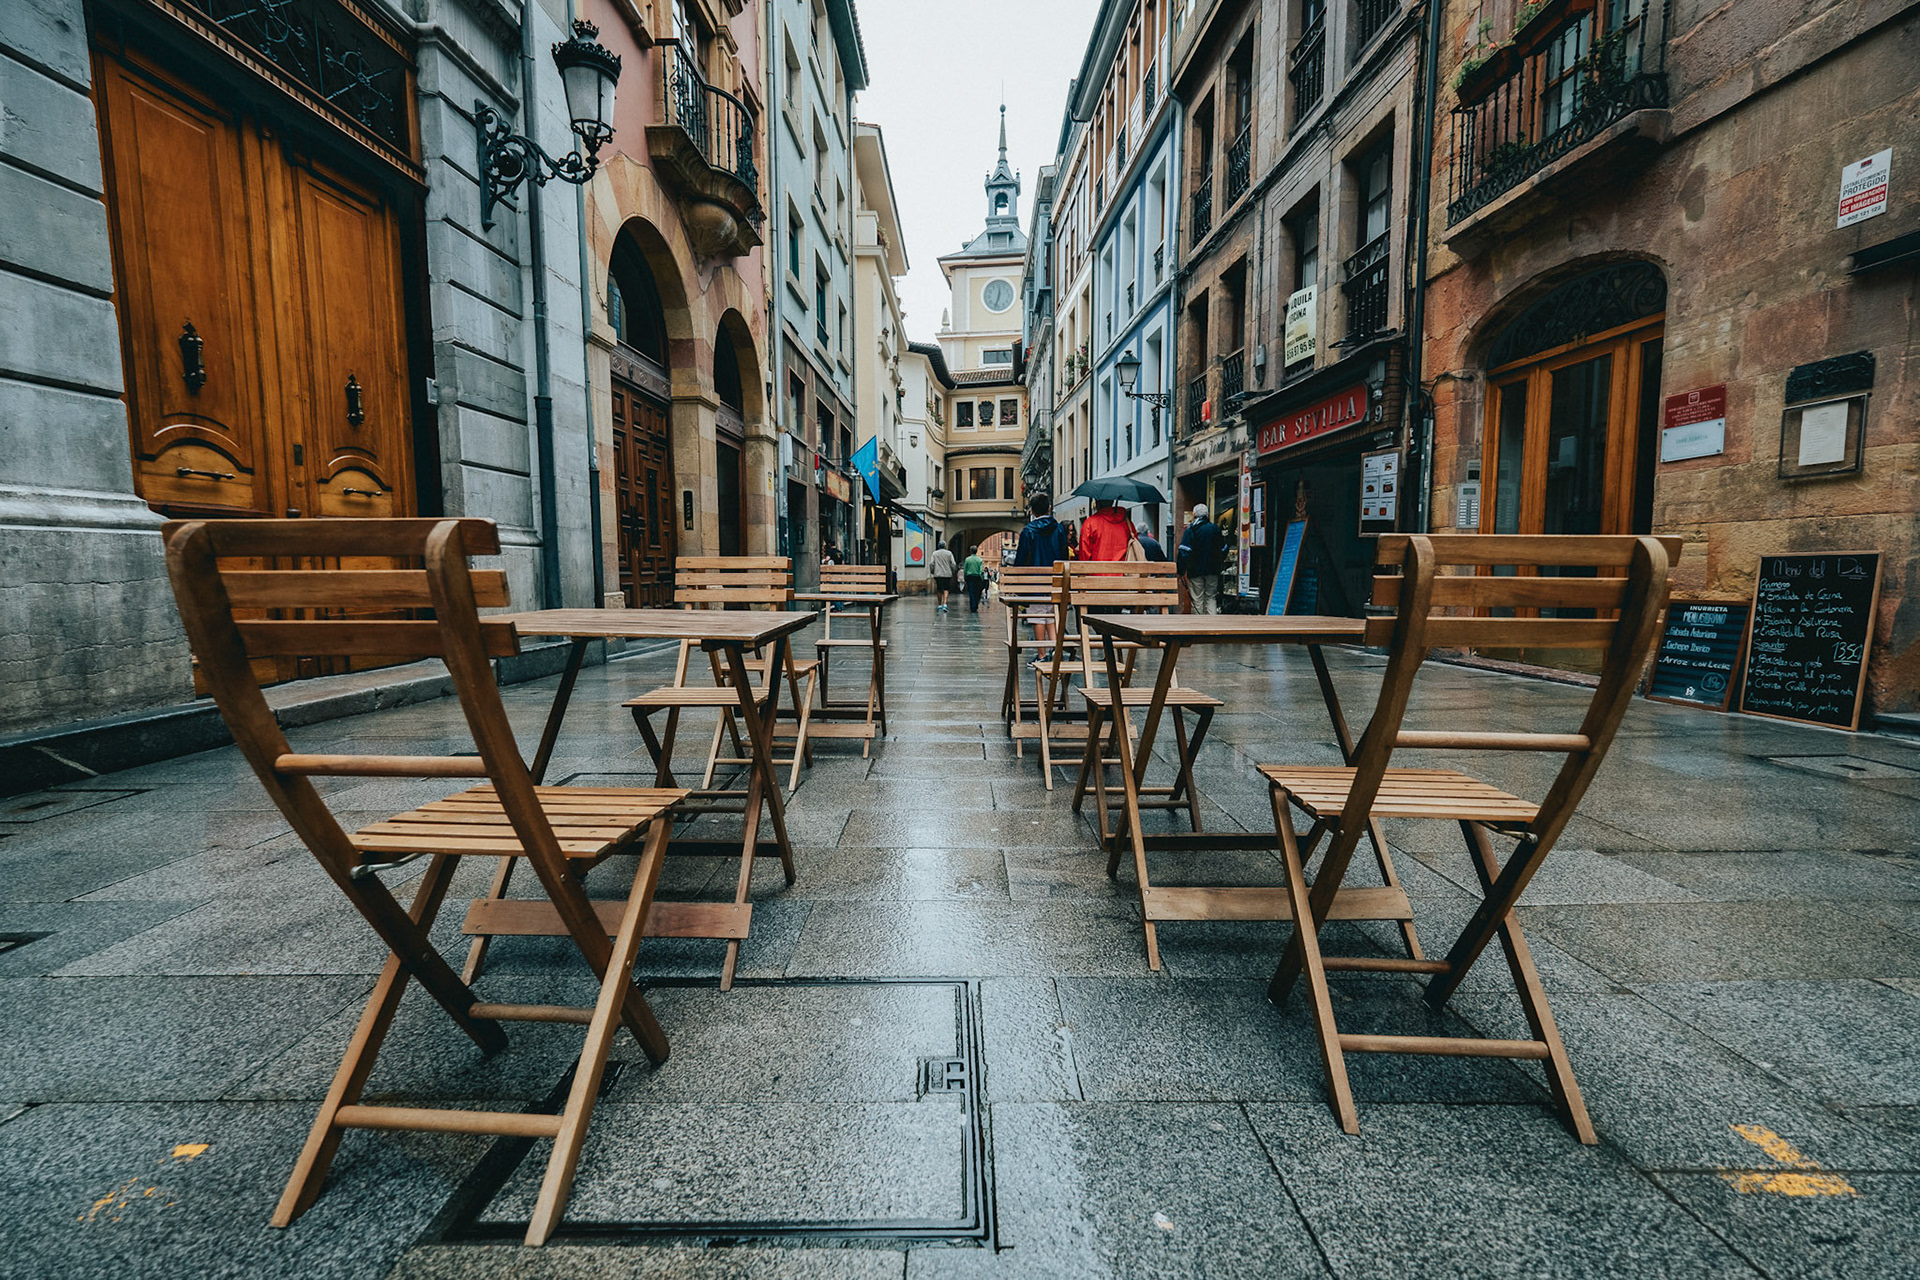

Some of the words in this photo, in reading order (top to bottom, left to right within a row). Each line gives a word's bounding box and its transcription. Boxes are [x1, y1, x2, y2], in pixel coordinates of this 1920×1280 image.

[1843, 169, 1887, 190] ESTABLECIMIENTO
[1843, 175, 1887, 197] PROTEGIDO
[1841, 198, 1853, 207] CON
[1840, 206, 1849, 215] DE
[1374, 404, 1383, 422] 9
[1263, 423, 1287, 449] BAR
[1294, 396, 1357, 437] SEVILLA
[1809, 559, 1826, 578] del
[1766, 590, 1800, 600] Ensalada
[1805, 590, 1814, 600] de
[1800, 602, 1810, 613] la
[1763, 614, 1793, 626] Fabada
[1798, 616, 1842, 628] Asturiana
[1690, 627, 1717, 639] Asturiana
[1816, 626, 1843, 640] Rusa
[1662, 655, 1688, 666] Arroz
[1789, 659, 1802, 668] con
[1804, 669, 1814, 679] al
